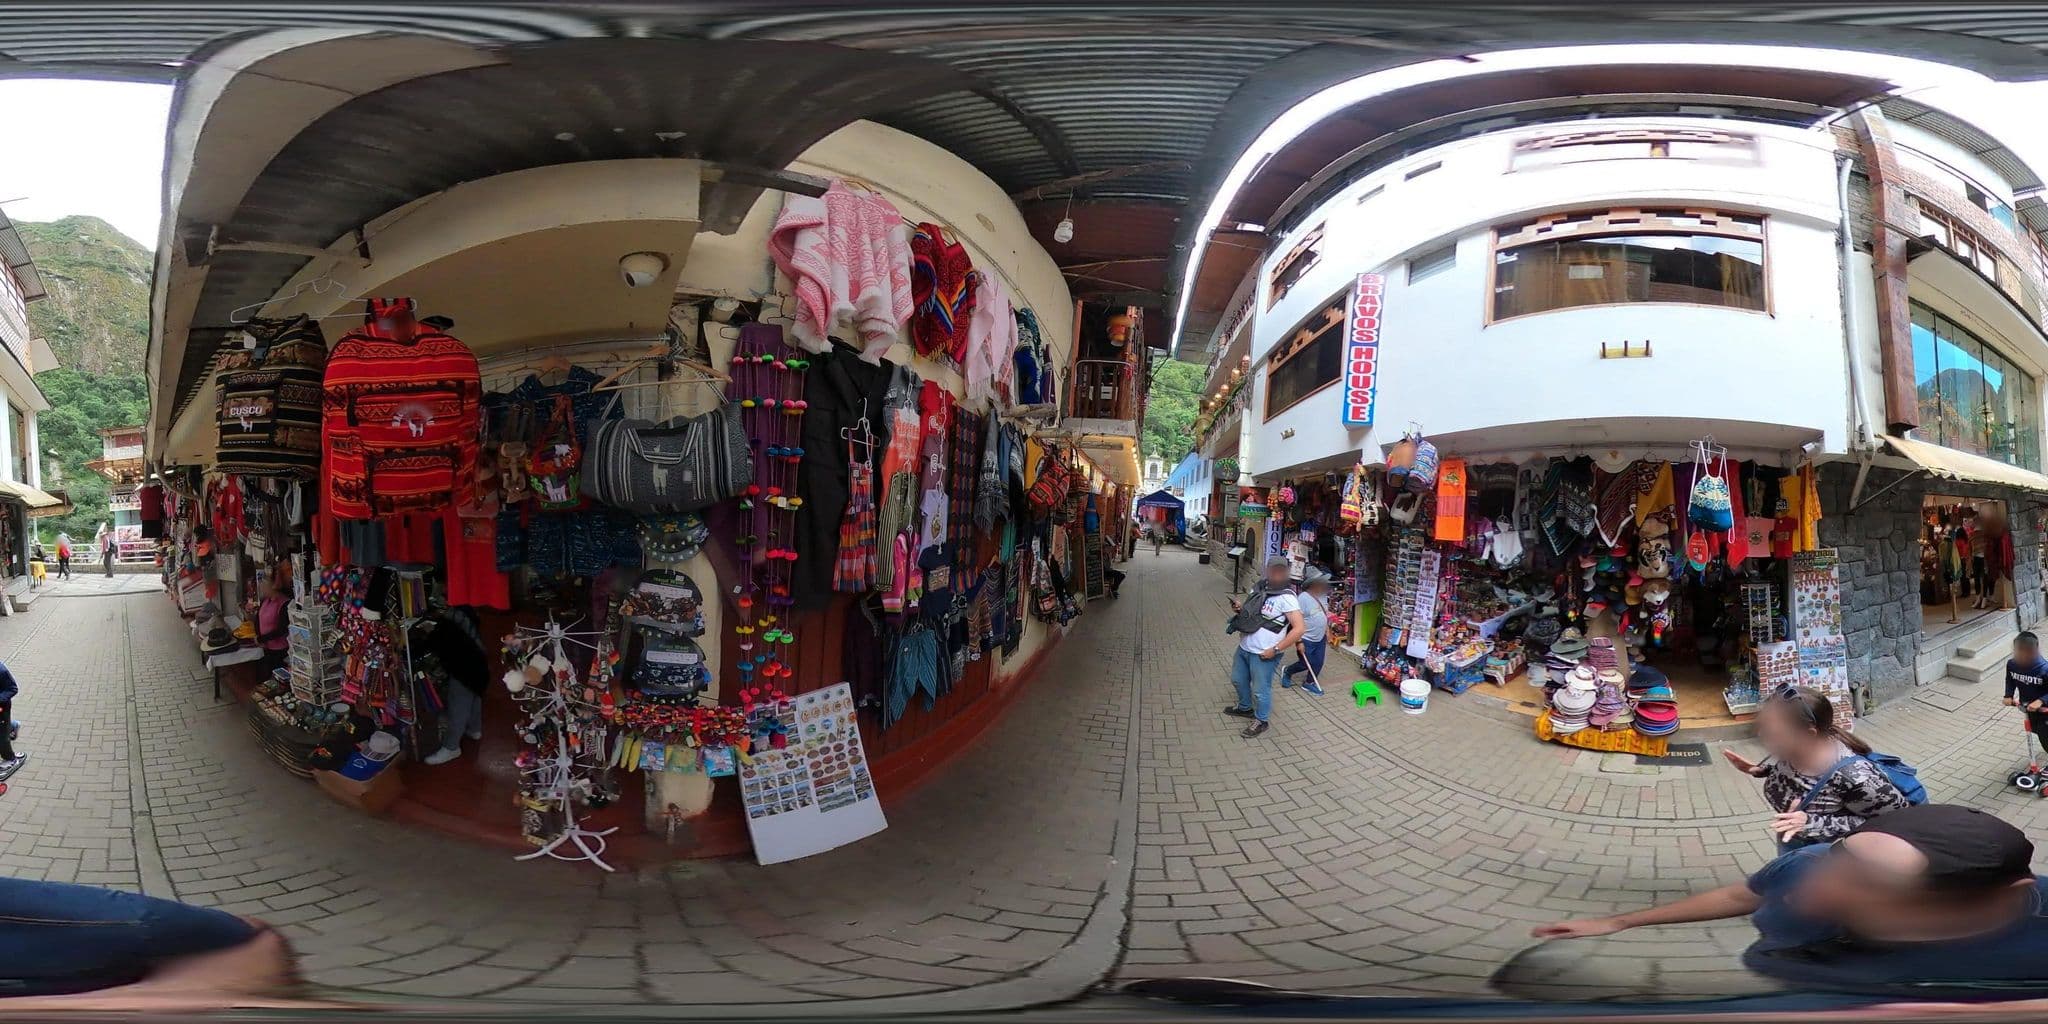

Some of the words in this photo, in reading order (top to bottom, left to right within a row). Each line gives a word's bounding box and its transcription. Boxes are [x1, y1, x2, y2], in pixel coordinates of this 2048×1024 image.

[1355, 274, 1382, 342] BRAVOS
[230, 406, 263, 416] CUSCO
[1350, 347, 1374, 421] HOUSE
